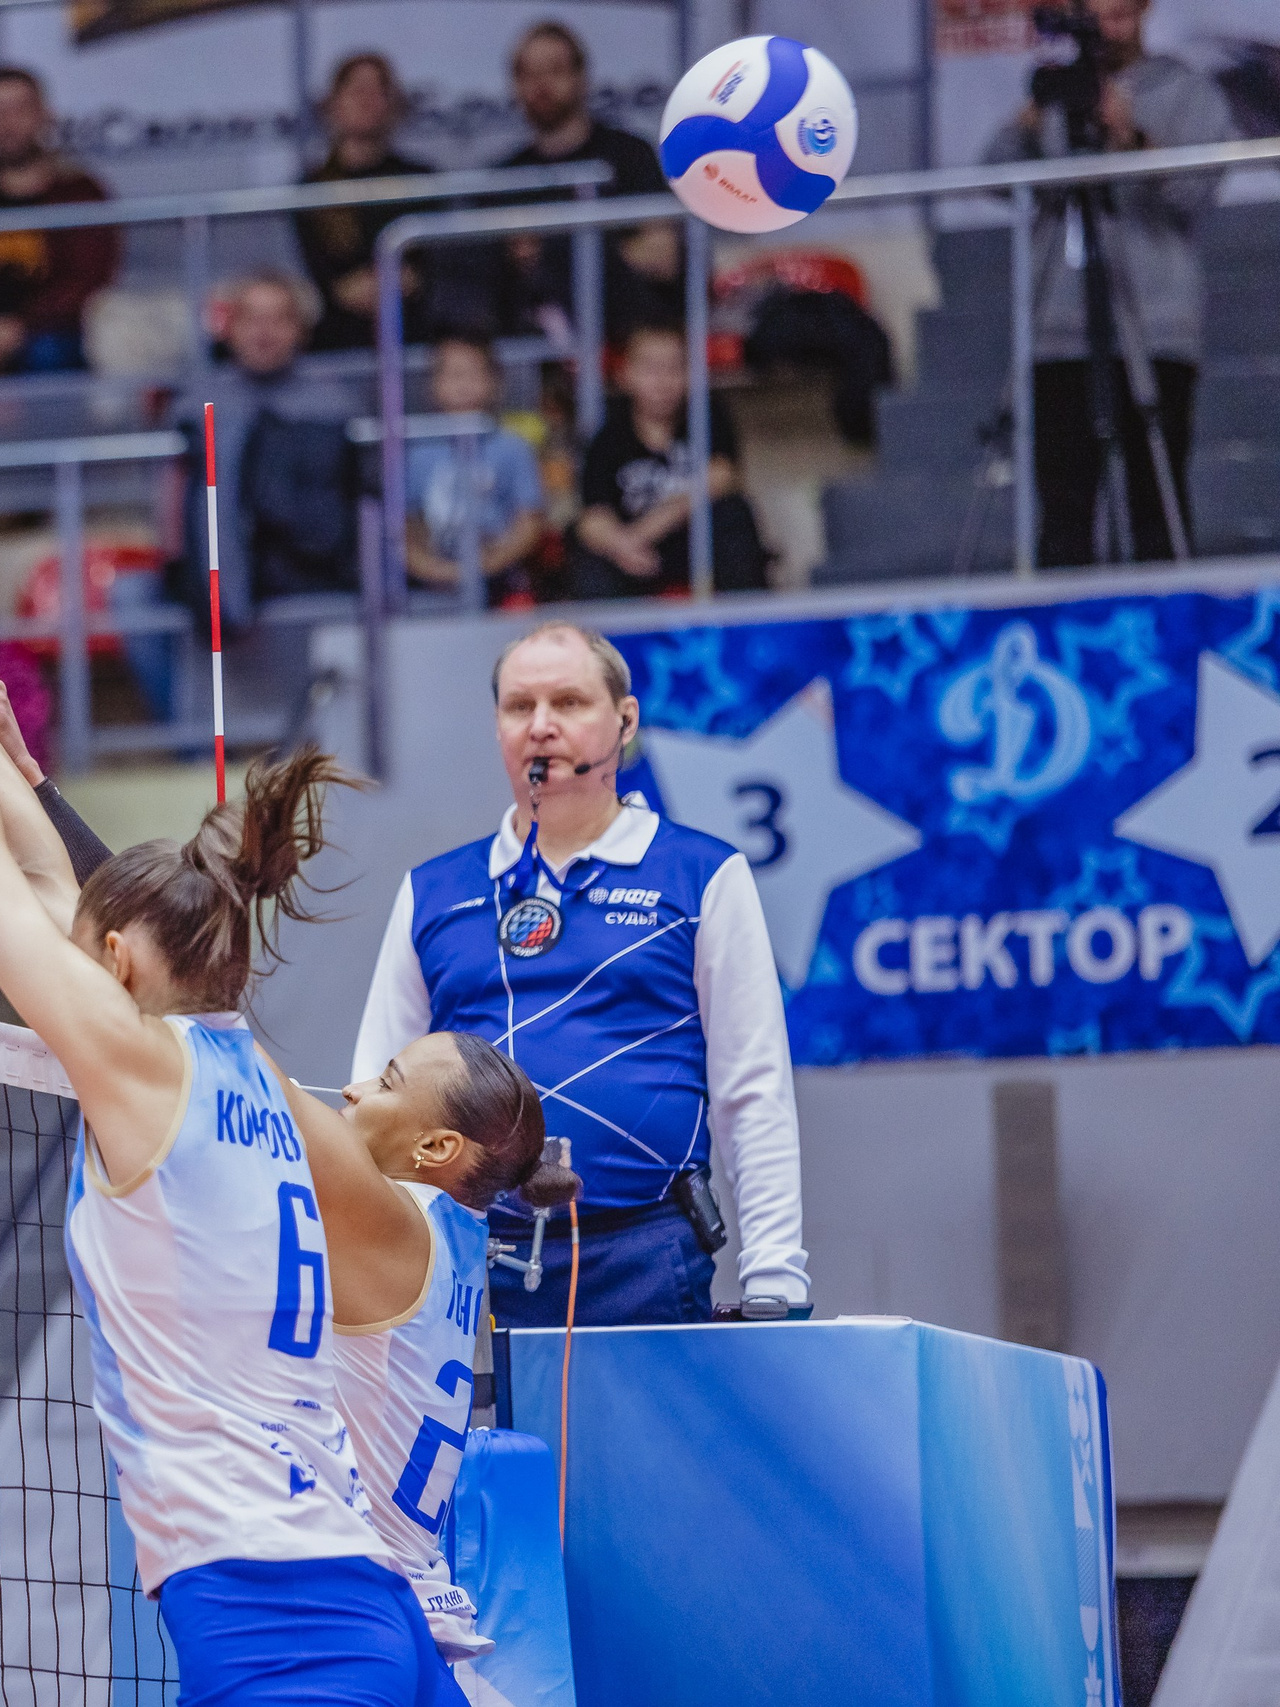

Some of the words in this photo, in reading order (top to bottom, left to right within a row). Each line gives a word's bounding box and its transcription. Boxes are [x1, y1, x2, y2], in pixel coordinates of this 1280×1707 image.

[732, 782, 787, 868] 3
[604, 911, 658, 926] СУДЬЯ
[607, 887, 662, 908] ВФВ
[852, 904, 1194, 996] СЕКТОР
[268, 1180, 326, 1360] 6
[392, 1359, 474, 1535] 2
[427, 1589, 464, 1612] ГРАНЬ
